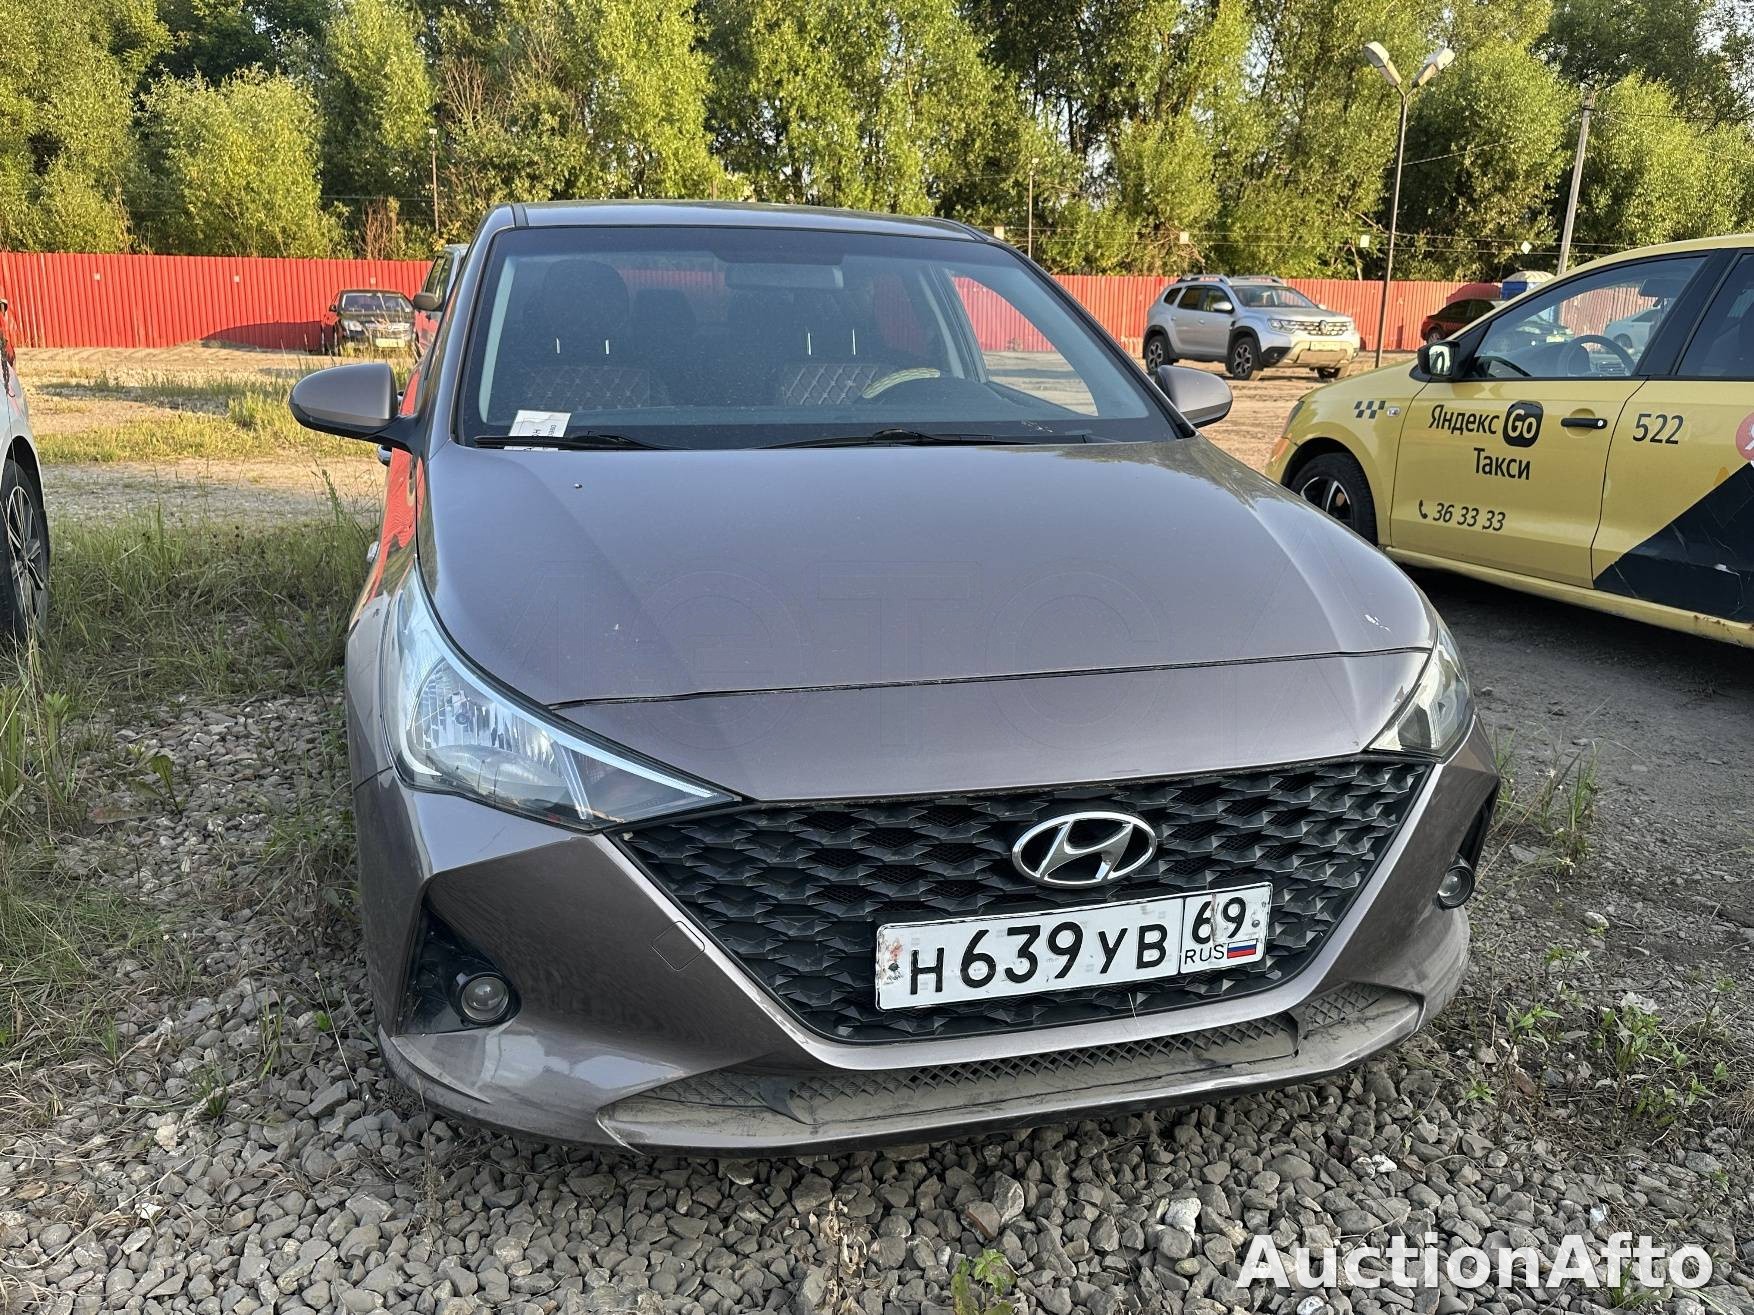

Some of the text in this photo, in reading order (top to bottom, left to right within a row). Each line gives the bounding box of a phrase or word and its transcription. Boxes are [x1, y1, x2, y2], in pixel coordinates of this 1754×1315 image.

[1428, 404, 1537, 439] Яндекс Go
[1632, 413, 1684, 445] 522
[1473, 447, 1531, 480] Такси
[1432, 502, 1506, 531] 36 33 33
[1184, 944, 1225, 965] RUS
